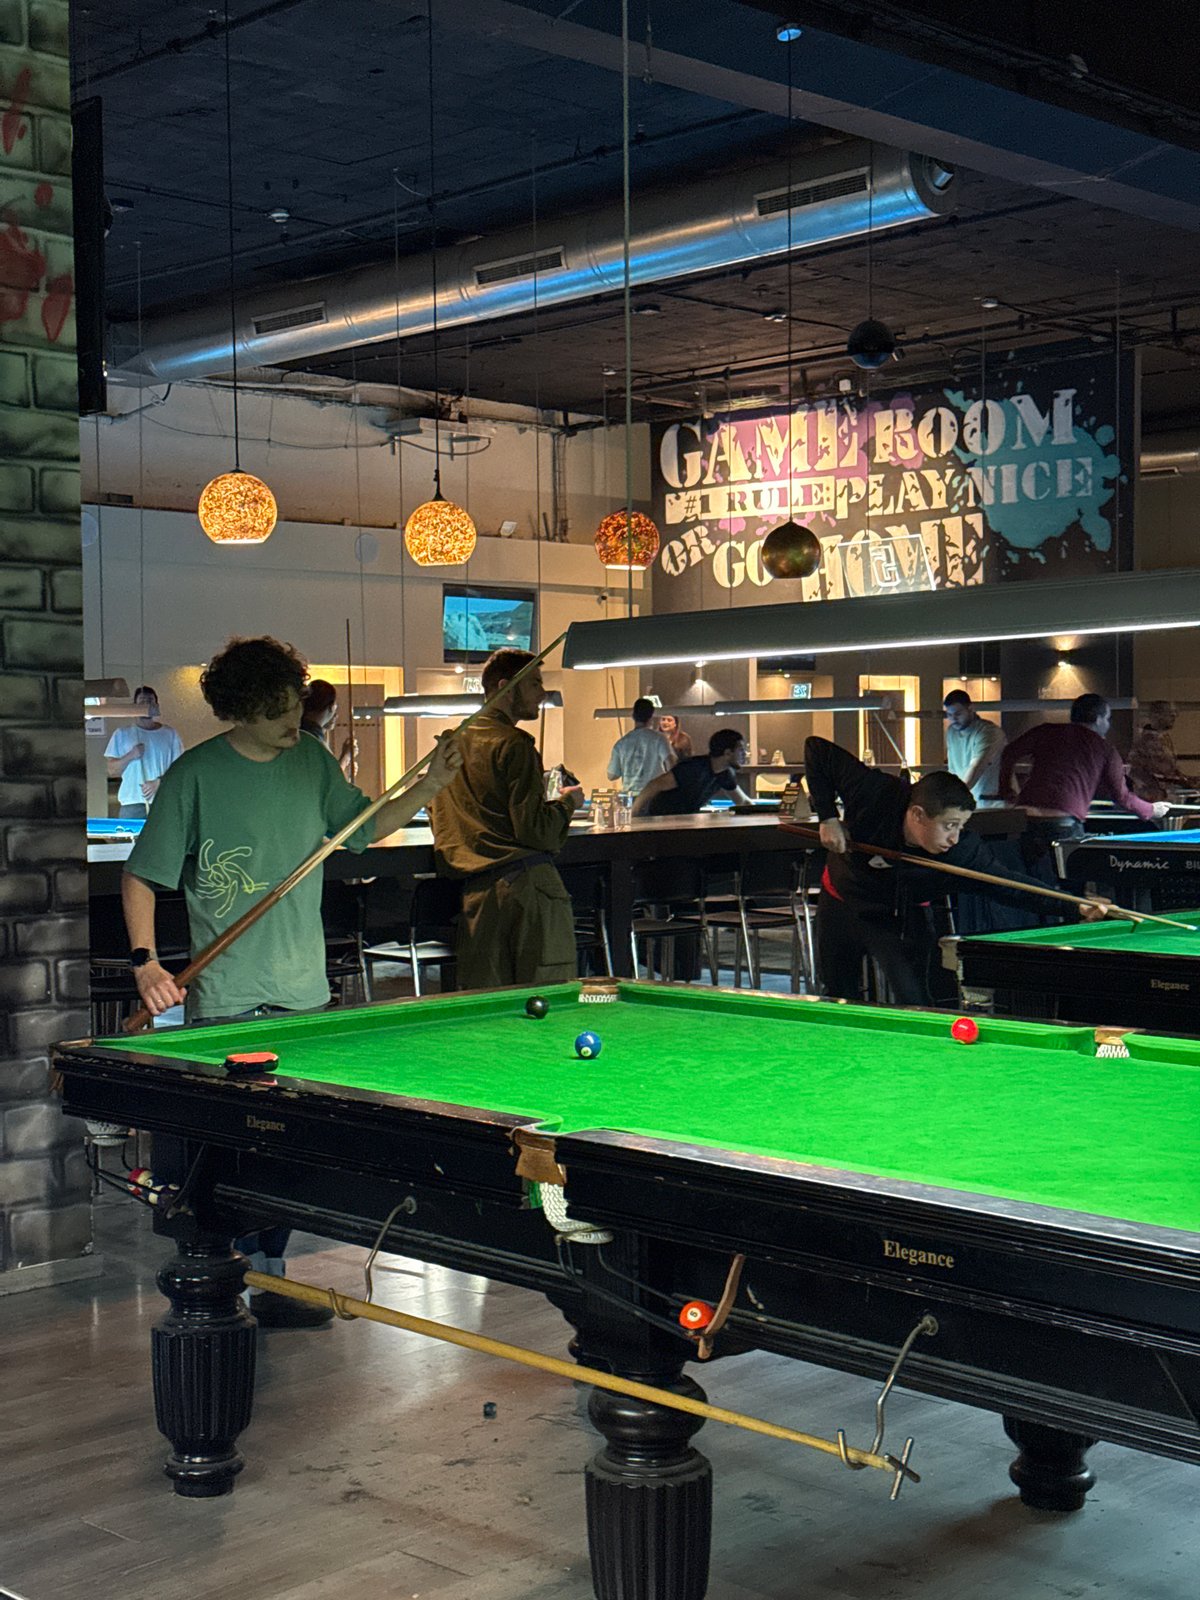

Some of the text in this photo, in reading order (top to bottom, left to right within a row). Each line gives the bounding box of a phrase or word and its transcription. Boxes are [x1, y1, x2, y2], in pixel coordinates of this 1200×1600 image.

[660, 388, 1078, 489] GAME ROOM
[684, 456, 1093, 520] #1 RULE: PLAY NICE
[660, 525, 716, 577] OR
[712, 539, 775, 589] GO
[801, 513, 984, 602] HOME
[1109, 854, 1170, 873] Dynamic
[246, 1115, 286, 1132] Elegance
[883, 1239, 955, 1269] Elegance
